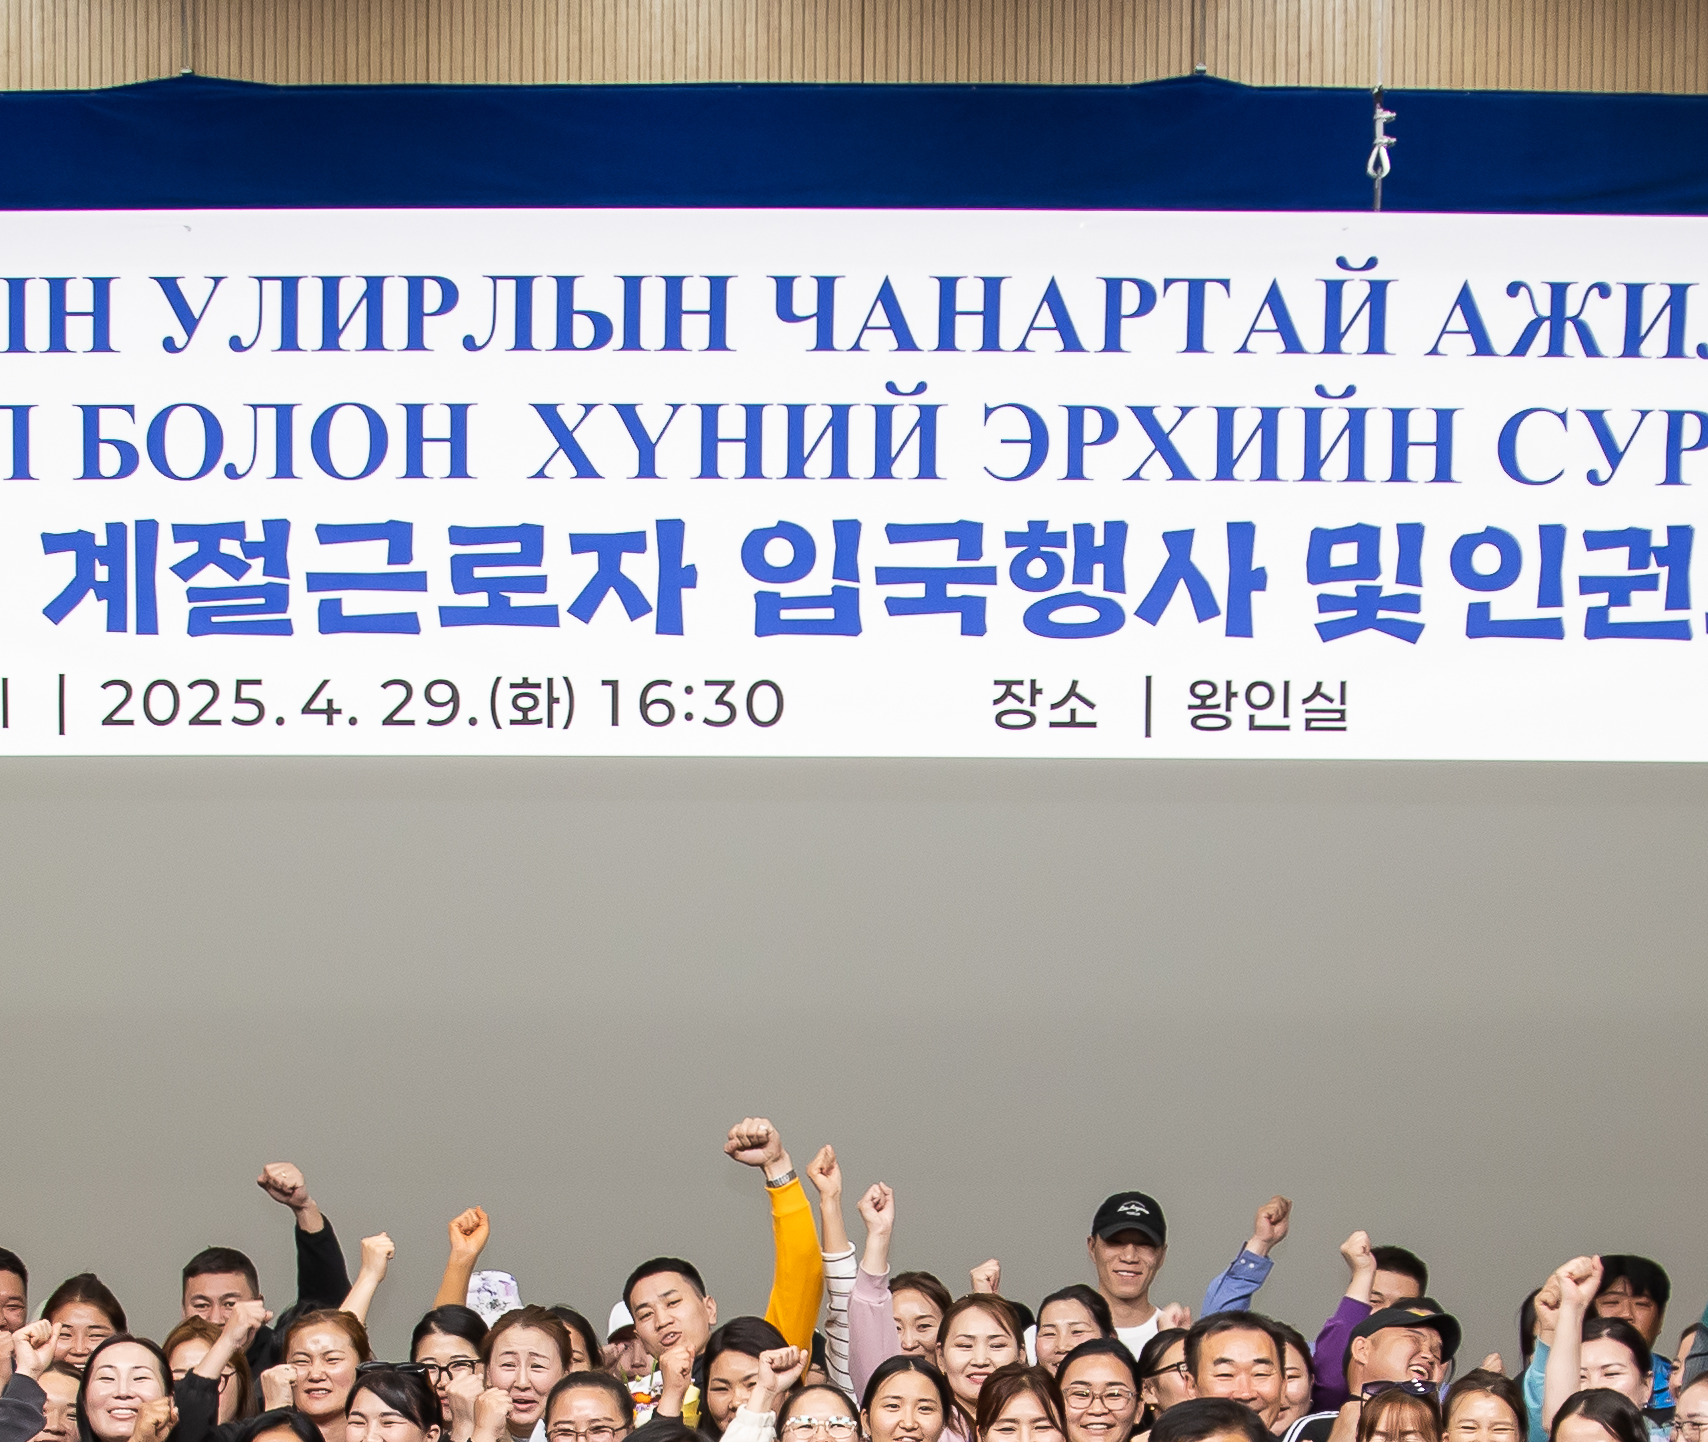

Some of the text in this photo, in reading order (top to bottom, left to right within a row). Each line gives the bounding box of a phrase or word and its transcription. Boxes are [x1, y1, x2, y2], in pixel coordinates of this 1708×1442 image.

[149, 276, 732, 353] УЛИРЛЫН
[770, 256, 1390, 354] ЧАНАРТАЙ
[74, 403, 473, 480] БОЛОН
[984, 385, 1457, 482] ЭРХИЙН
[41, 519, 697, 637] 계절근로자
[741, 519, 1267, 639] 입국행사
[602, 680, 783, 727] 16:30
[993, 679, 1346, 731] 장소 왕인실
